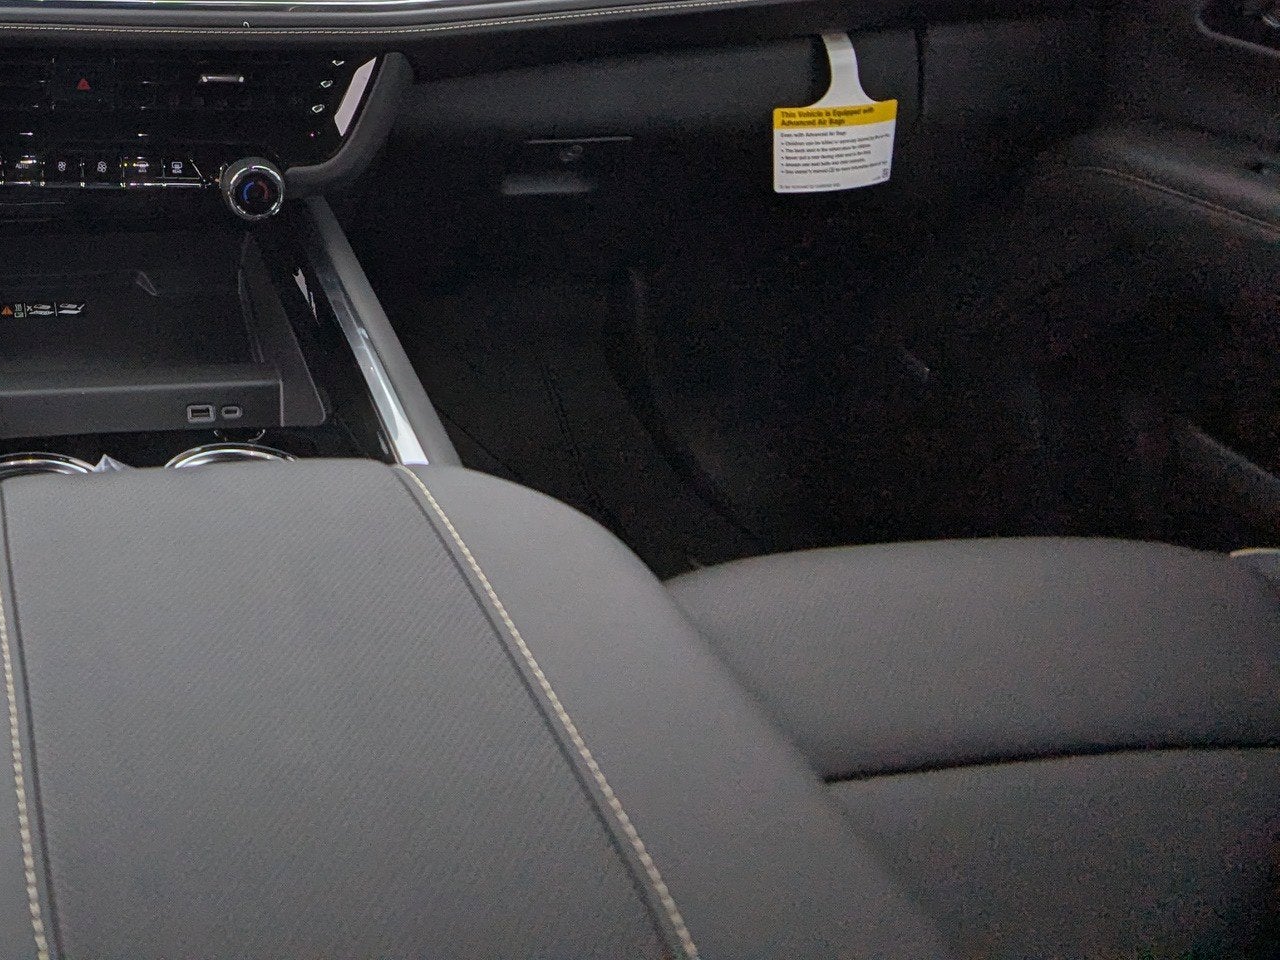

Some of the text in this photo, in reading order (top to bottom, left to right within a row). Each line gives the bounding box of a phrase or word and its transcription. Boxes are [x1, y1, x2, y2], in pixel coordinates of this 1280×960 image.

[781, 111, 796, 119] This
[832, 108, 861, 118] Equipped
[862, 106, 875, 114] with
[781, 119, 817, 127] Advanced
